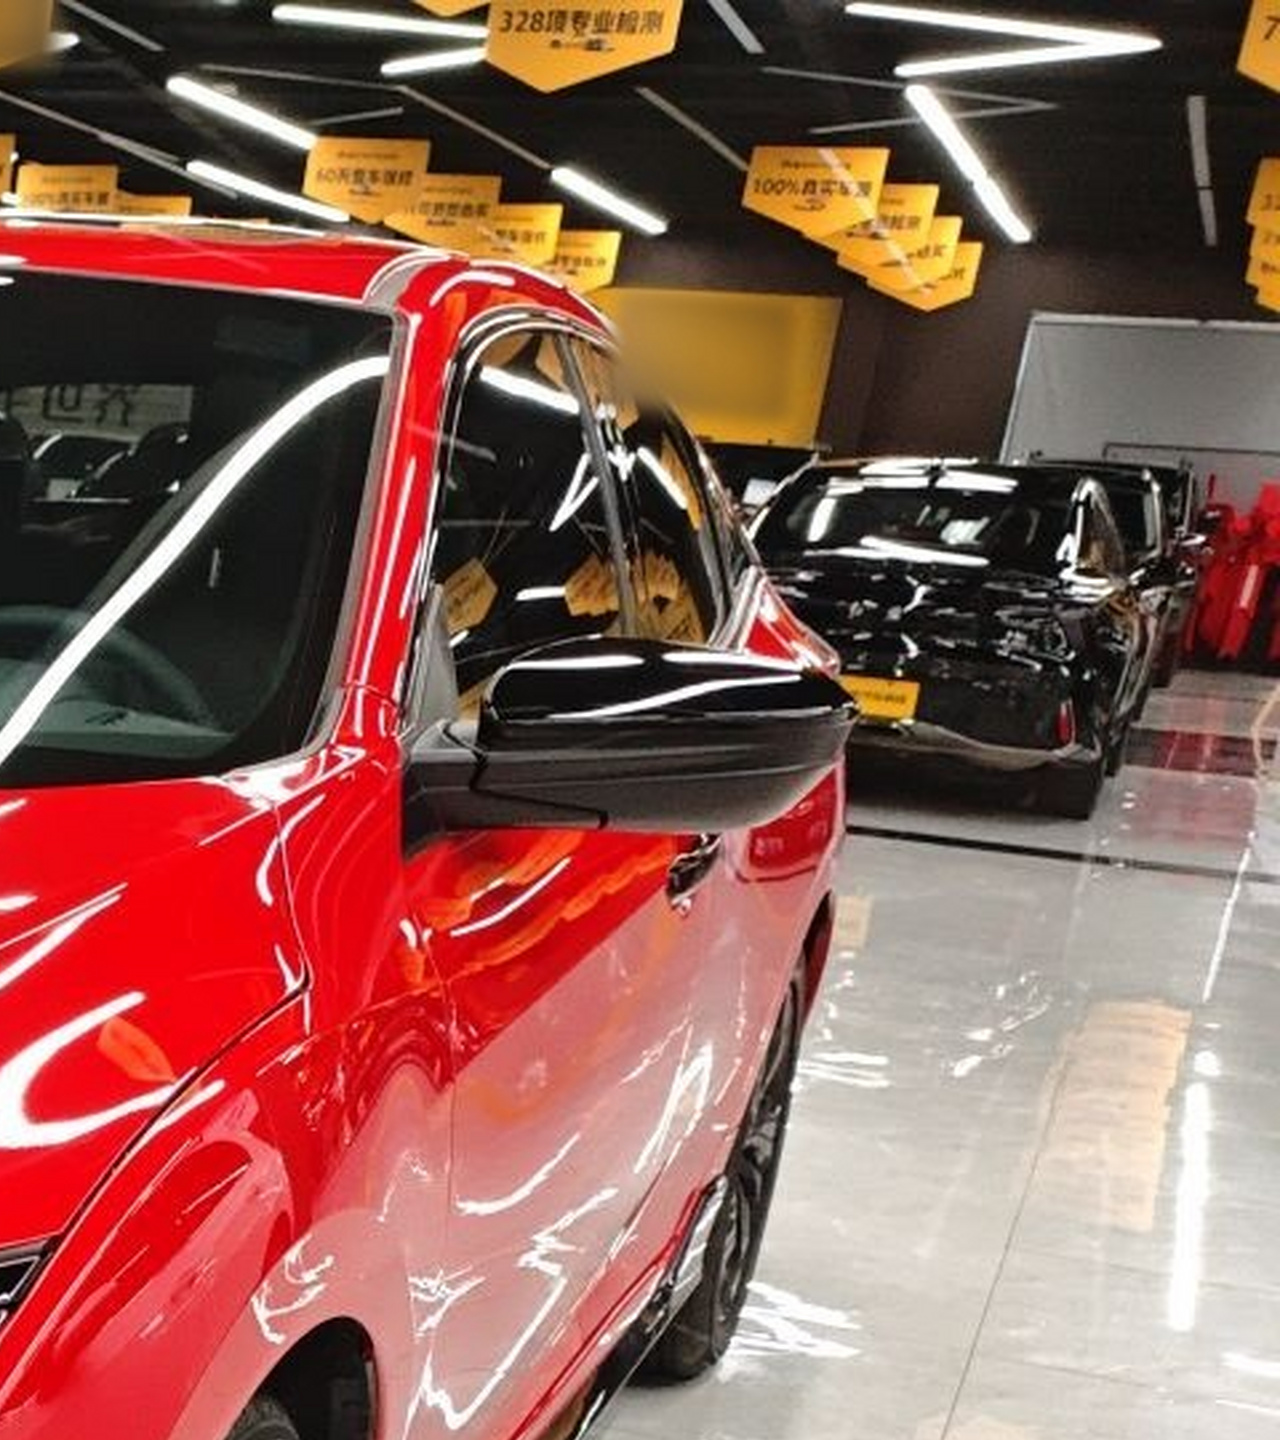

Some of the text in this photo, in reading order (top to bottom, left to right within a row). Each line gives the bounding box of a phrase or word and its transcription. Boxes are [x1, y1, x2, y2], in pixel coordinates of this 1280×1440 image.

[499, 9, 664, 36] 328项专业检测
